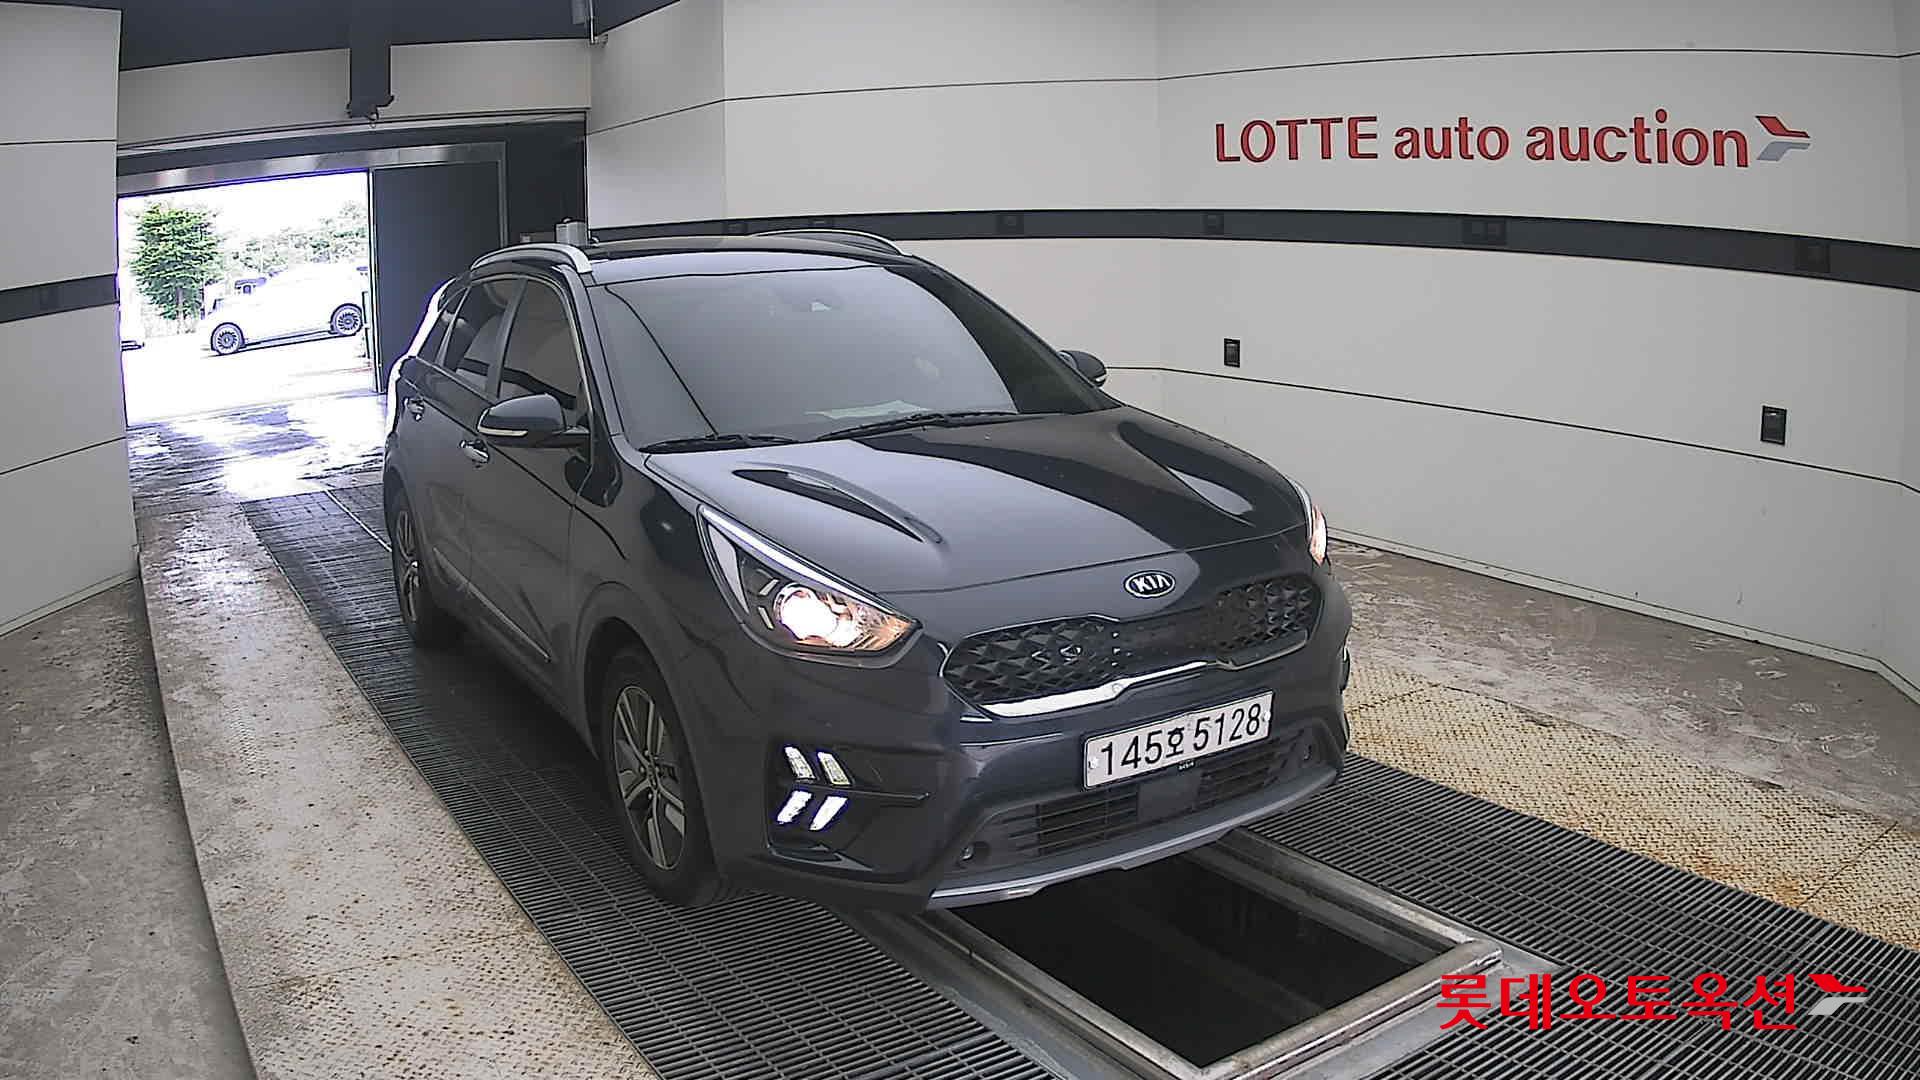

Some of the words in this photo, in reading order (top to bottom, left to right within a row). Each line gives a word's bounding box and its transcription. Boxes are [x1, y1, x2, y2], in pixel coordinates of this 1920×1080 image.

[1215, 116, 1378, 162] LOTTE
[1393, 117, 1510, 161] auto
[1526, 109, 1750, 167] auction
[1130, 572, 1172, 594] KIA
